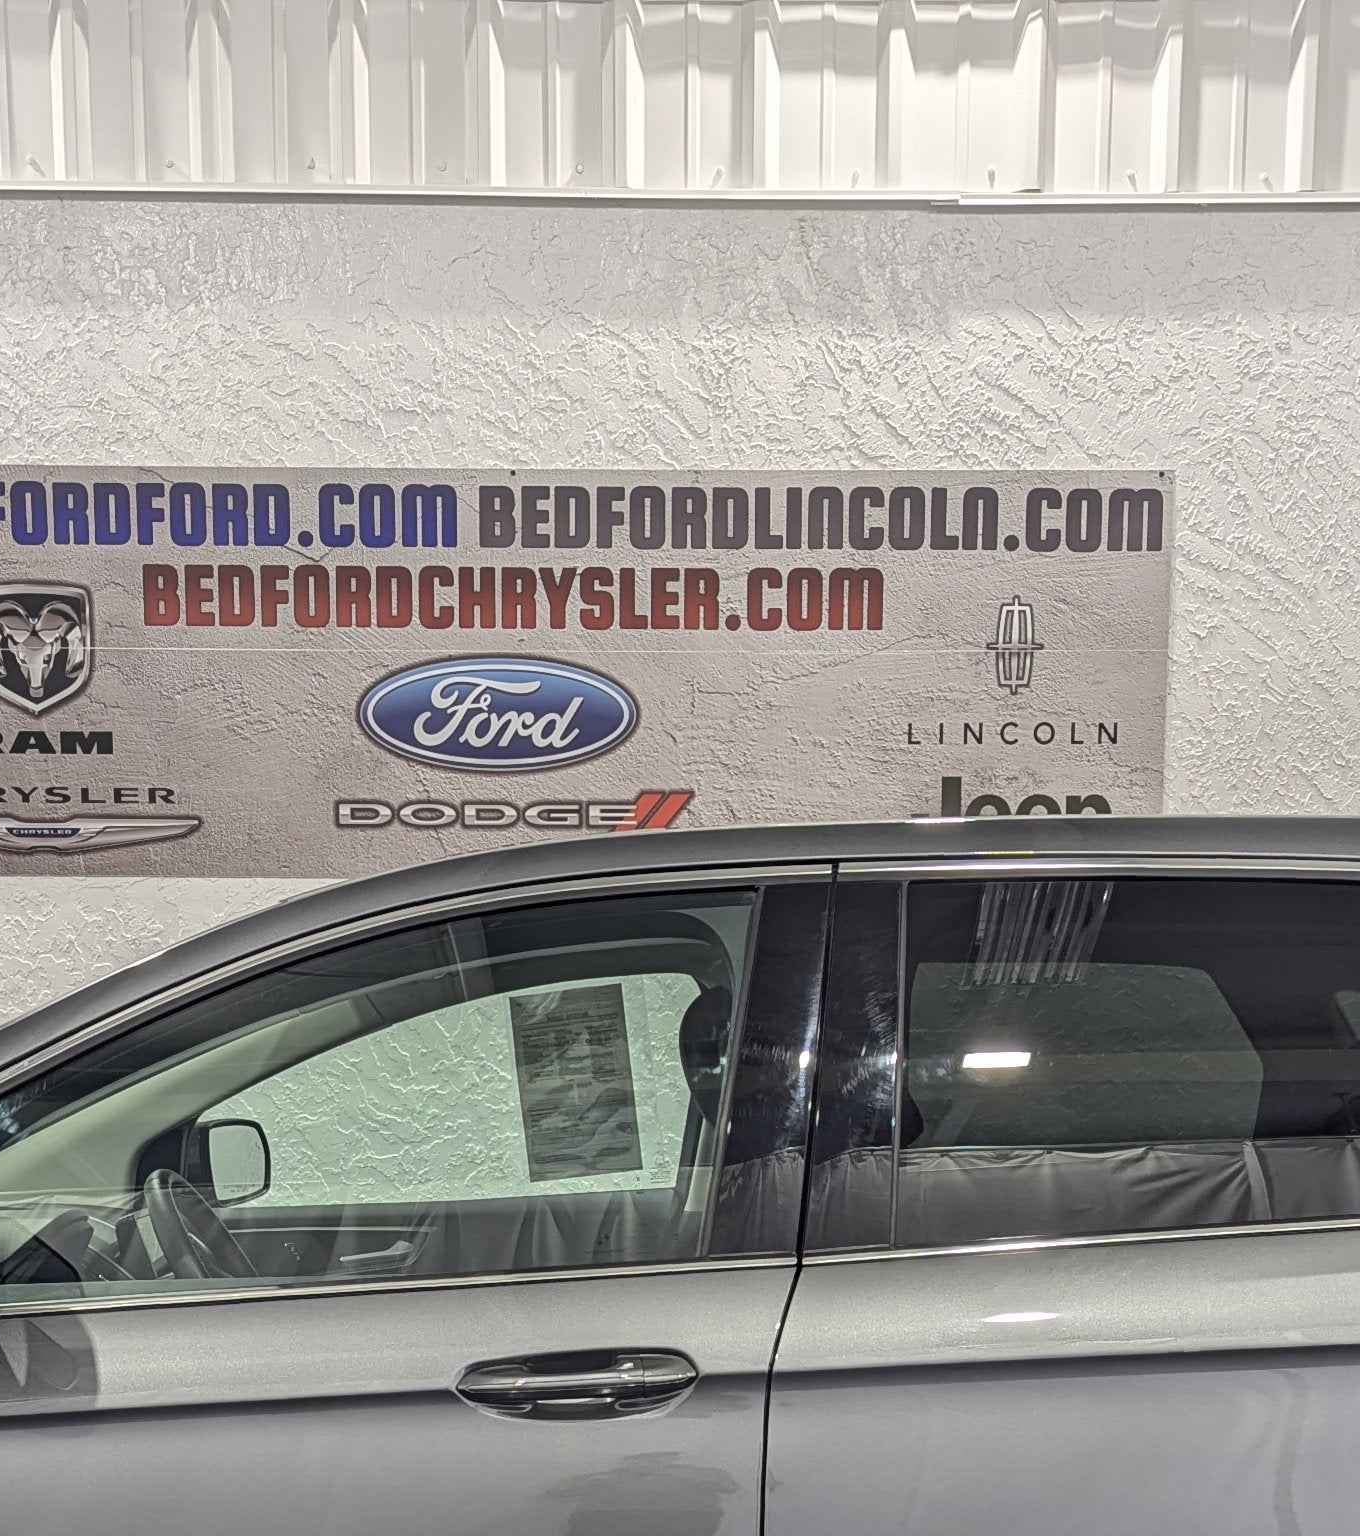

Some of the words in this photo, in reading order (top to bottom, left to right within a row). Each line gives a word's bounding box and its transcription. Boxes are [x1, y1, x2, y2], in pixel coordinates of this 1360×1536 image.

[478, 485, 1164, 553] BEDFORDLINCOLN.COM
[141, 563, 885, 632] BEDFORDCHRYSLER.COM
[413, 675, 585, 748] Ford
[906, 721, 1119, 746] LINCOLN
[338, 802, 639, 827] DODGE
